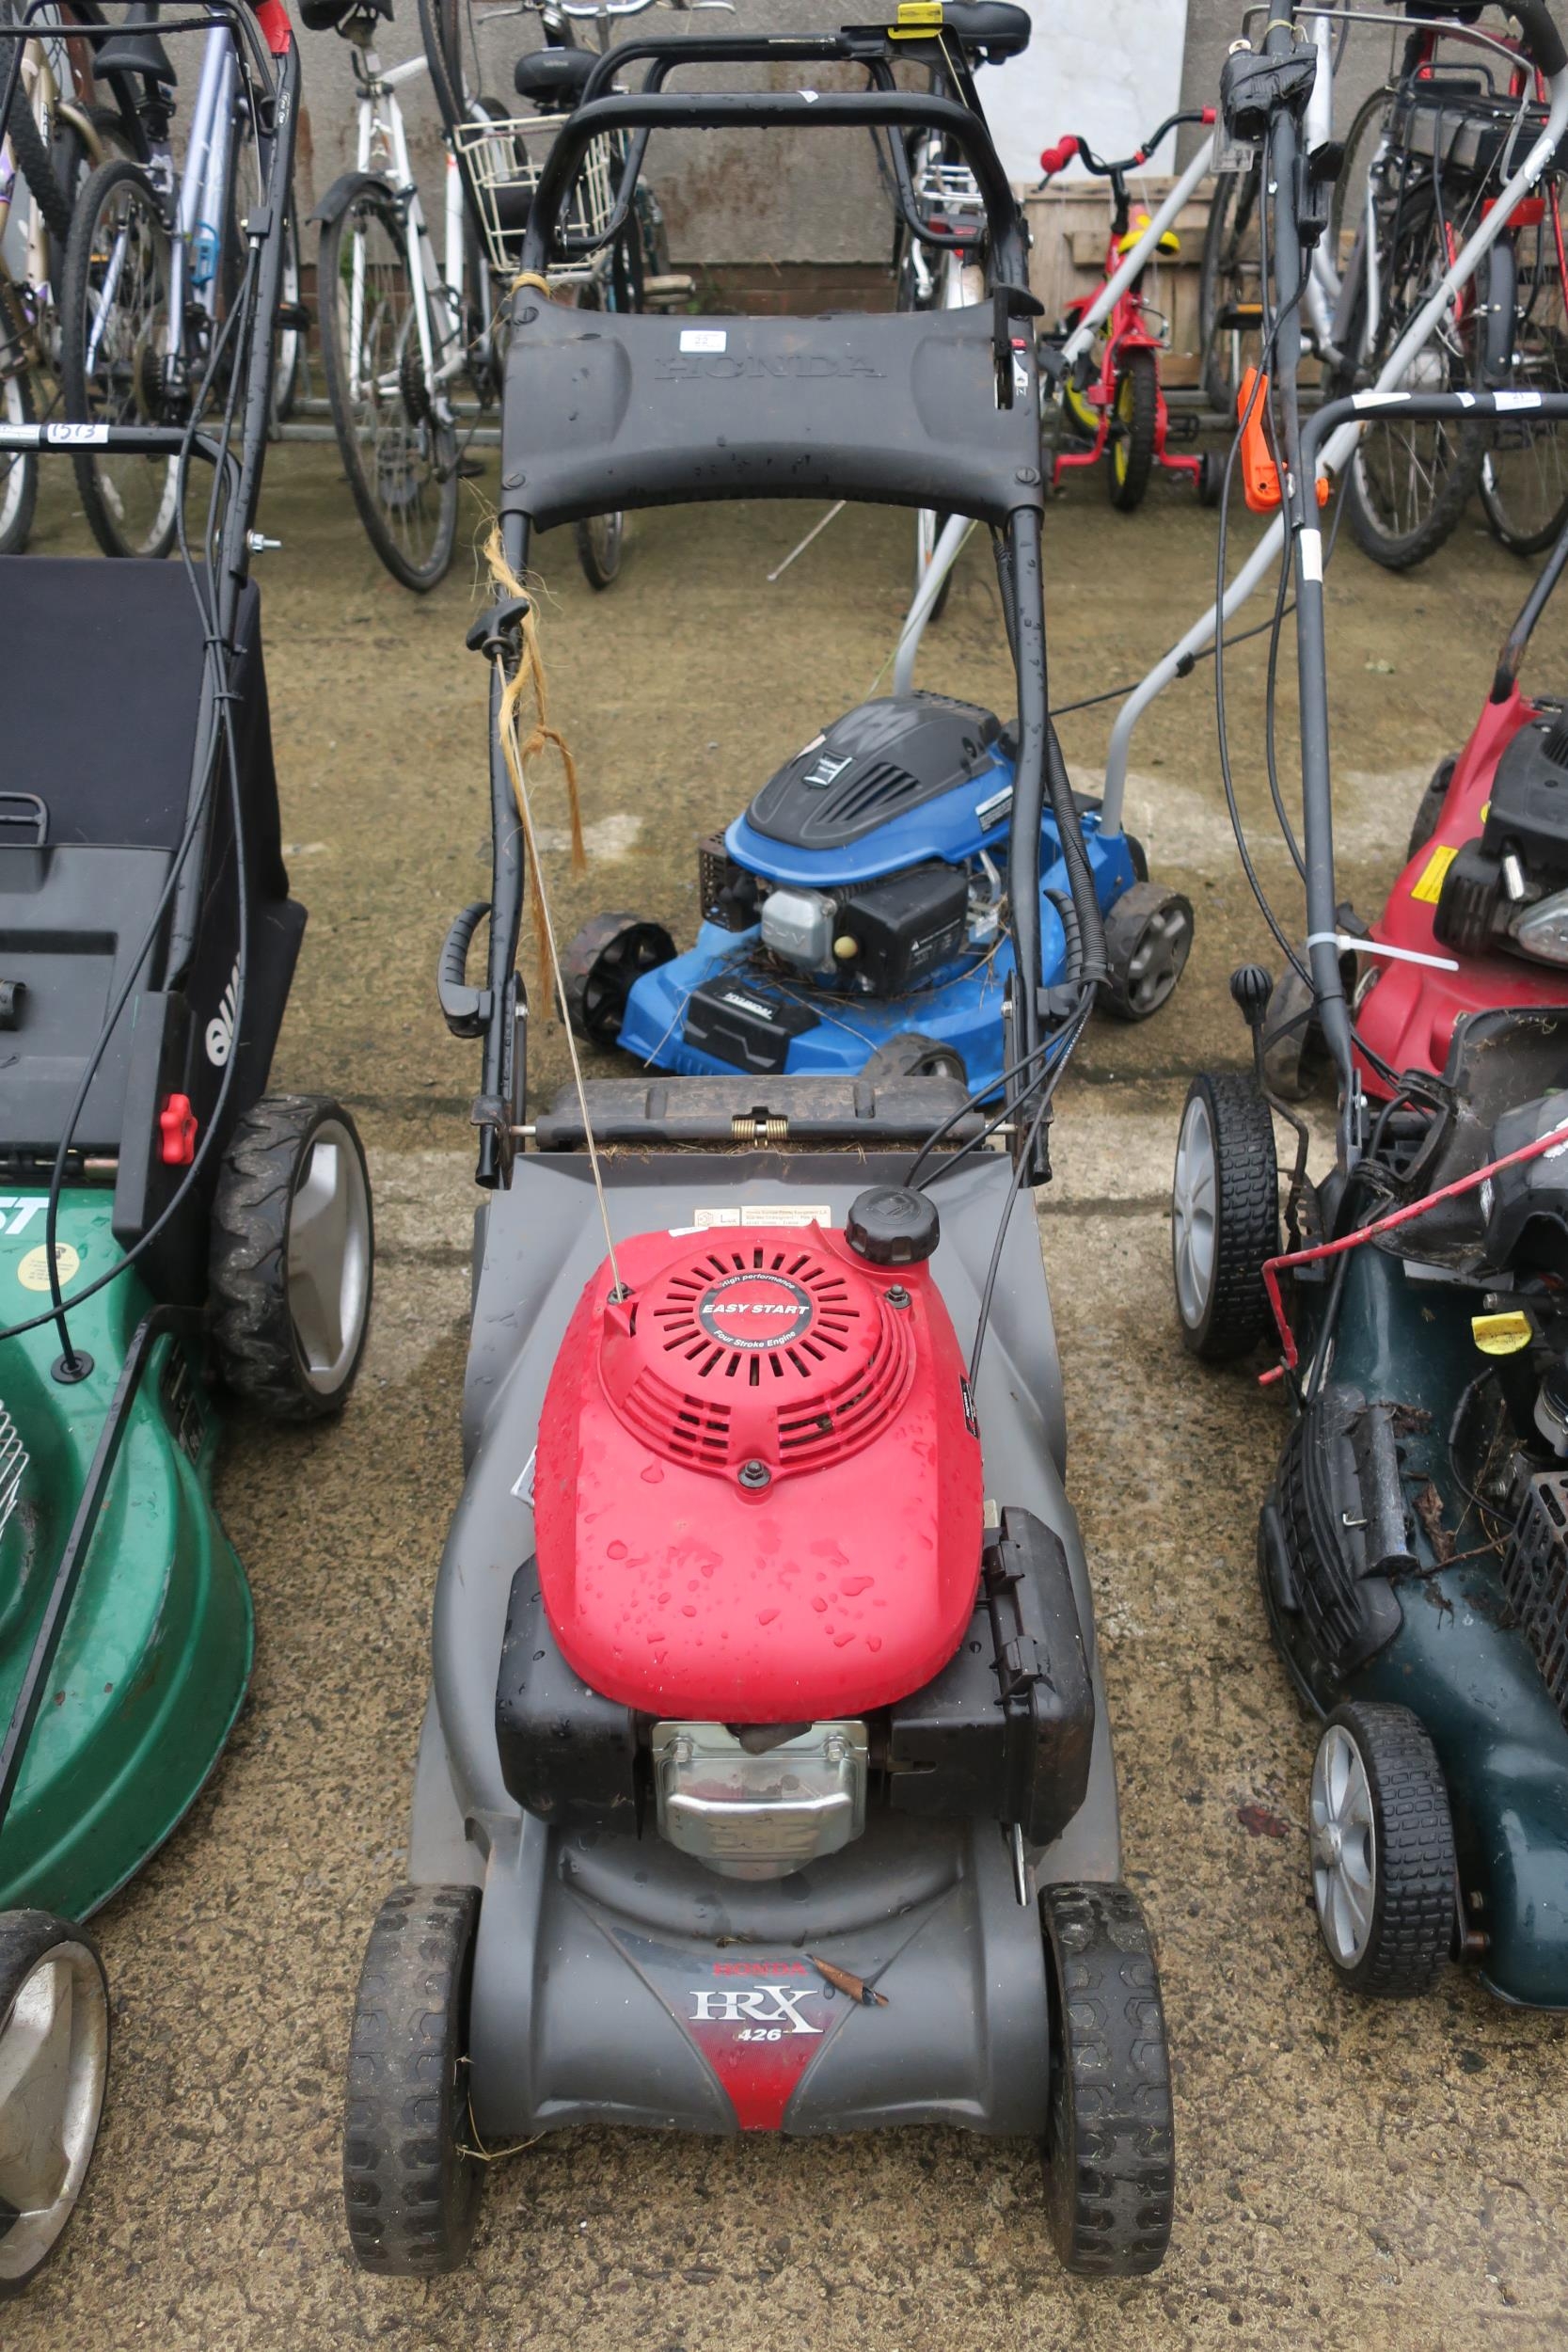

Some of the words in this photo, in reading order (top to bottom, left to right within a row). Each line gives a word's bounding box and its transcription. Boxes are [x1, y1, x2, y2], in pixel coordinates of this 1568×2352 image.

[654, 356, 888, 379] HONDA
[721, 1277, 740, 1287] High
[742, 1273, 796, 1290] performance
[702, 1304, 750, 1313] EASY
[752, 1304, 809, 1315] START
[713, 1329, 734, 1343] Four
[734, 1340, 765, 1348] Stroke
[767, 1331, 796, 1347] Engine
[713, 1962, 809, 1977] HONDA
[689, 1985, 824, 2034] HRX
[737, 2028, 783, 2042] 426
